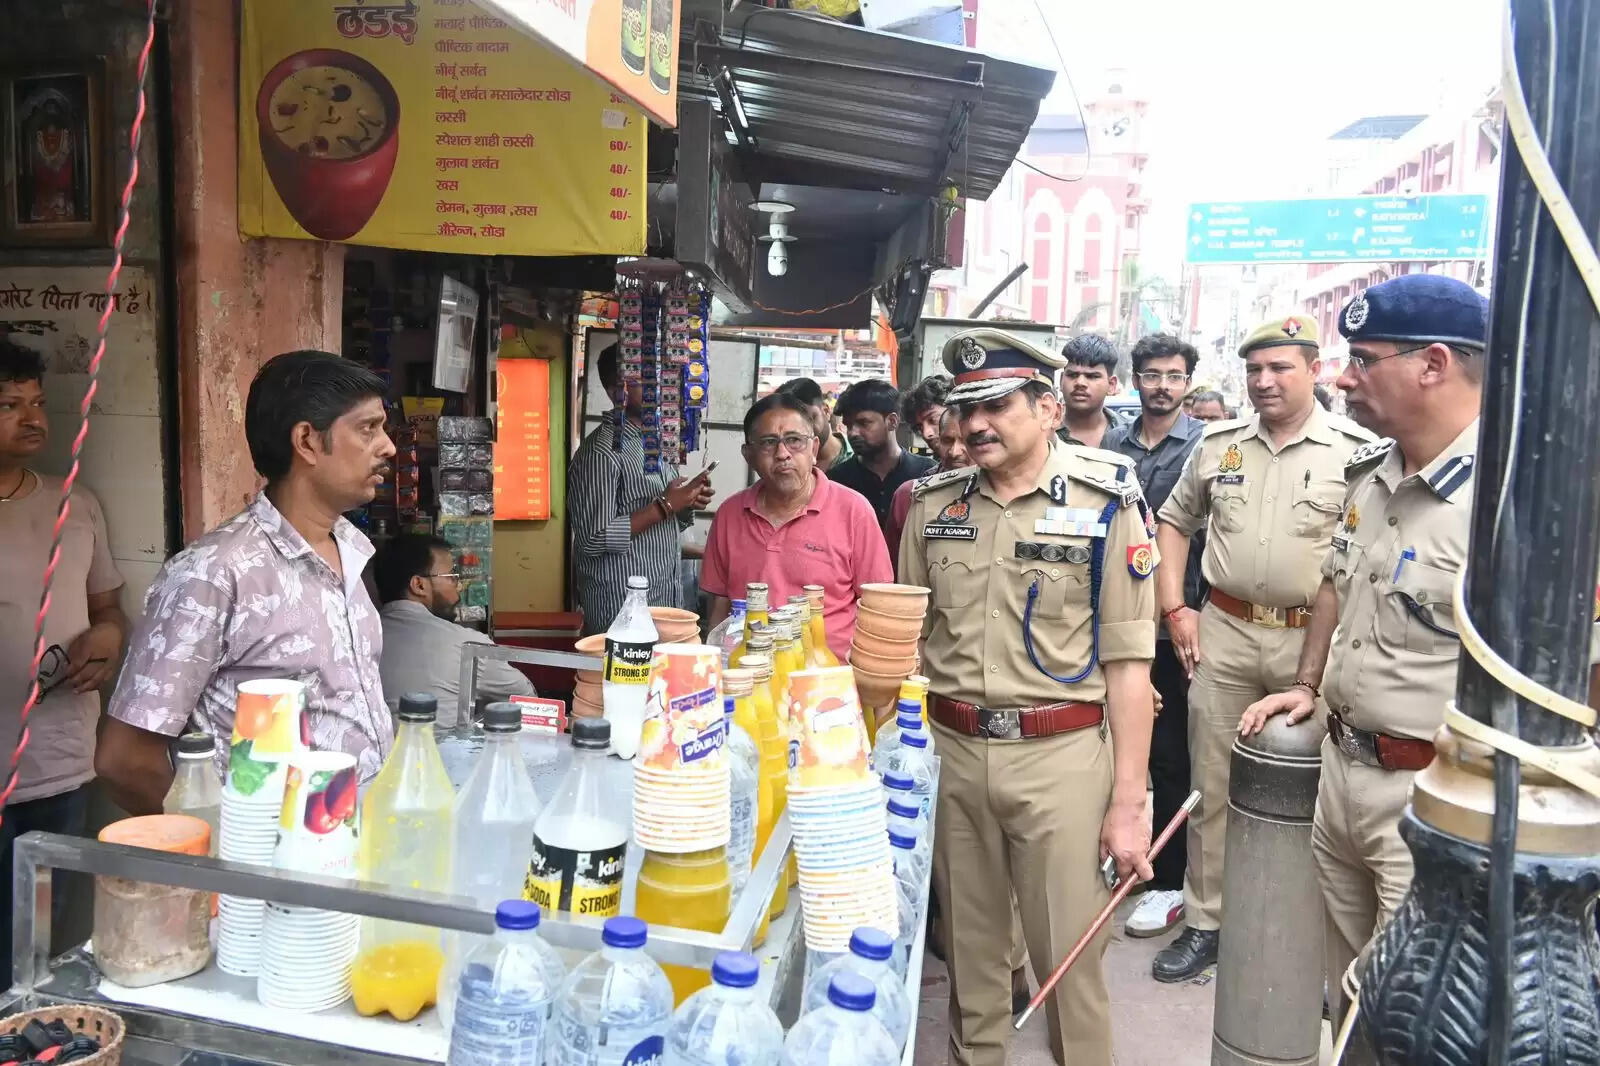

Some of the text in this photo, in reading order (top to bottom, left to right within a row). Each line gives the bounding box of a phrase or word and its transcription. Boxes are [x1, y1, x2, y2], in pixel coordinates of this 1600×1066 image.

[490, 87, 544, 102] मसालेदार
[546, 88, 571, 103] सोडा
[435, 109, 466, 123] लस्सी
[435, 132, 534, 148] स्पेशल शाही लस्सी
[609, 140, 632, 152] 60/-
[435, 157, 468, 172] गुलाब
[609, 163, 632, 175] 40/-
[435, 179, 459, 191] खस
[609, 187, 632, 199] 40/-
[473, 203, 506, 218] गुलाब
[609, 210, 632, 221] 40/-
[480, 224, 505, 238] सोडा
[0, 283, 34, 310] गरेट
[926, 527, 971, 536] MOHIT AGARWAL
[623, 648, 651, 660] kinley
[614, 667, 640, 678] STRONG
[579, 889, 618, 914] STRONG
